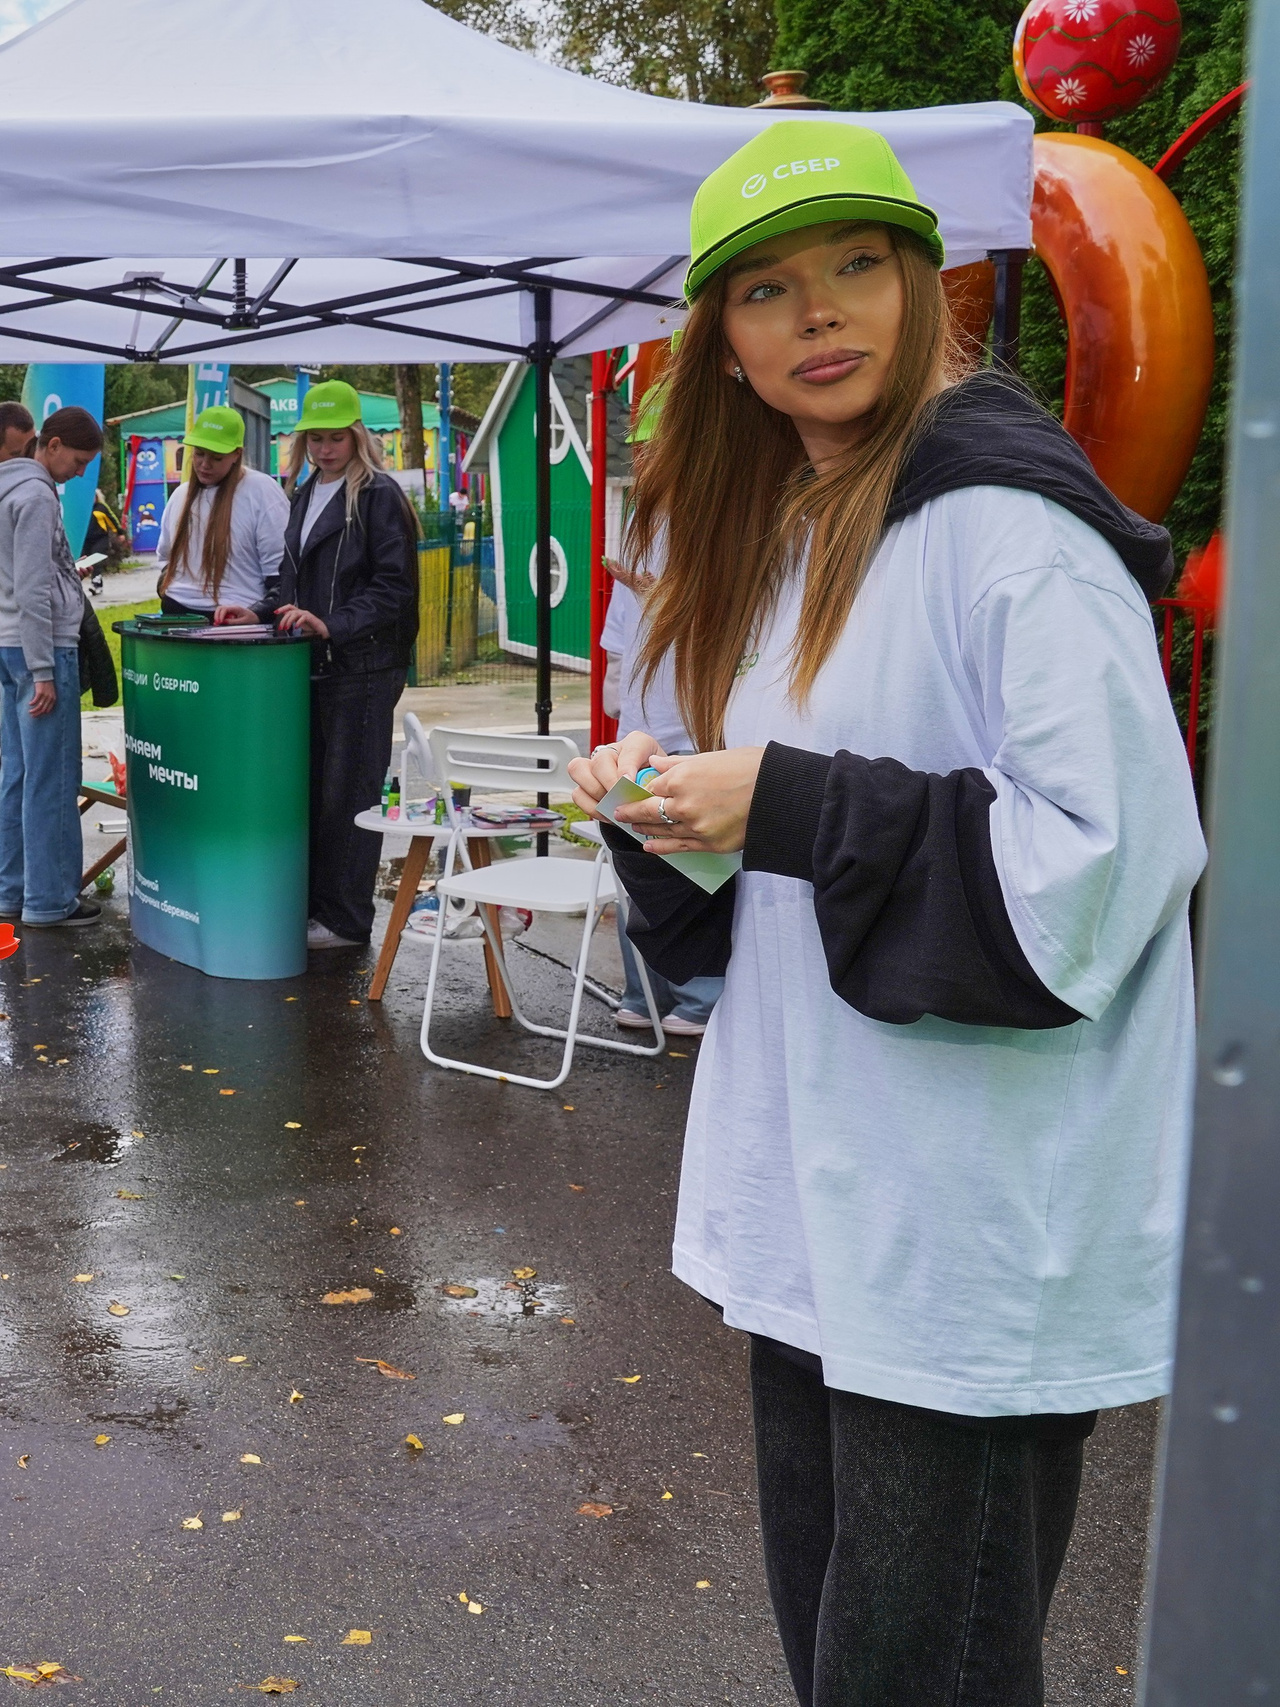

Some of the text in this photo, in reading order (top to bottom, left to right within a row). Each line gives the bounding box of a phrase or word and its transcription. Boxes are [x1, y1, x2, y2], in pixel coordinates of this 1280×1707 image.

[773, 157, 840, 180] СБЕР
[161, 676, 179, 691] СБЕР
[179, 680, 200, 694] НПФ
[148, 763, 198, 791] мечты
